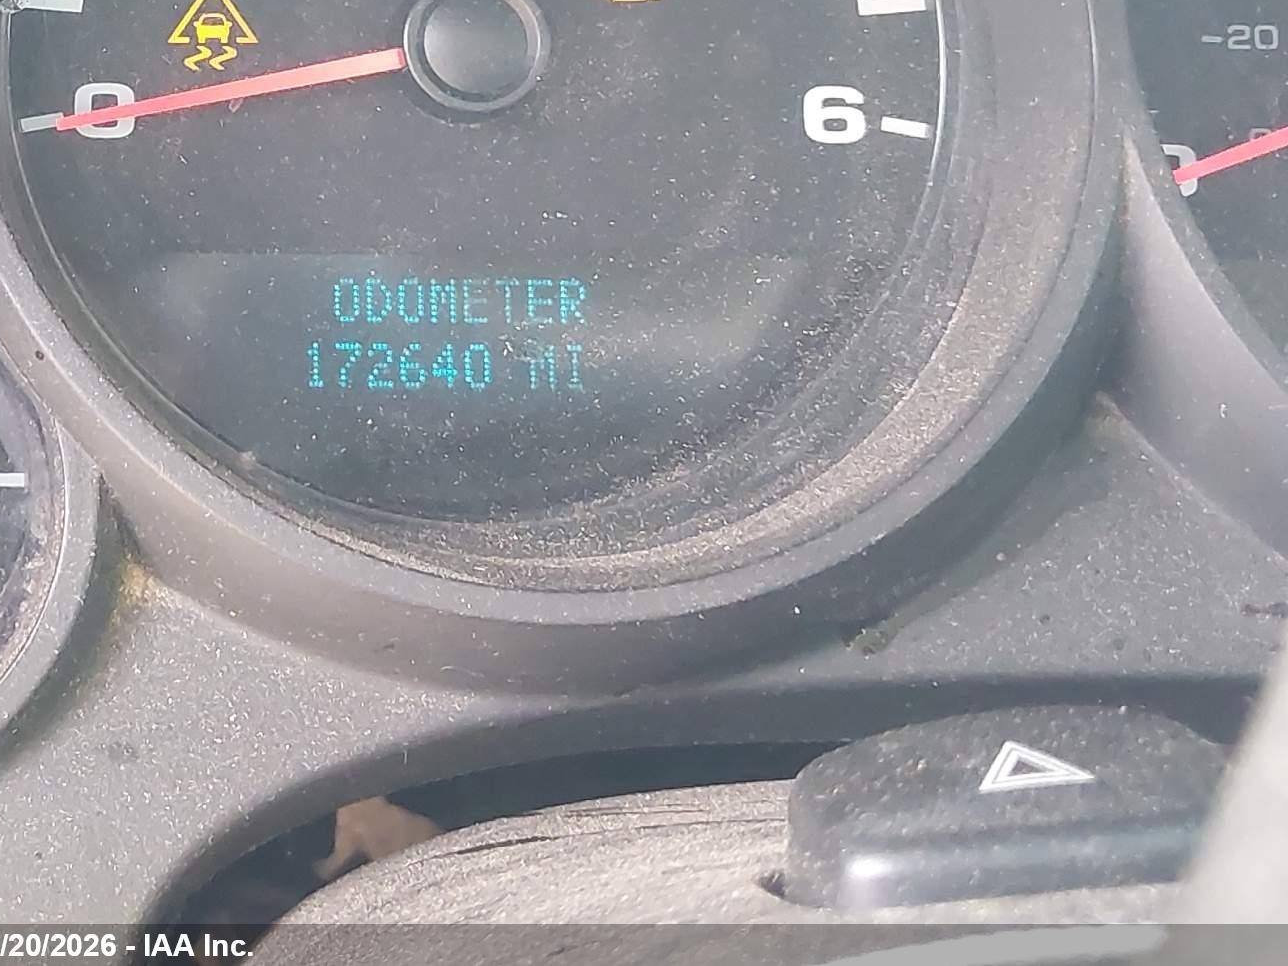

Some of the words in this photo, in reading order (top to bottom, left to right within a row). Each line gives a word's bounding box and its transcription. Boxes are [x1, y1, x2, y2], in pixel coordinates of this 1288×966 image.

[1226, 24, 1279, 50] 20
[74, 82, 136, 139] 0
[803, 85, 866, 144] 6
[333, 277, 588, 324] ODOMETER
[306, 342, 492, 389] 172640
[524, 343, 585, 390] MI
